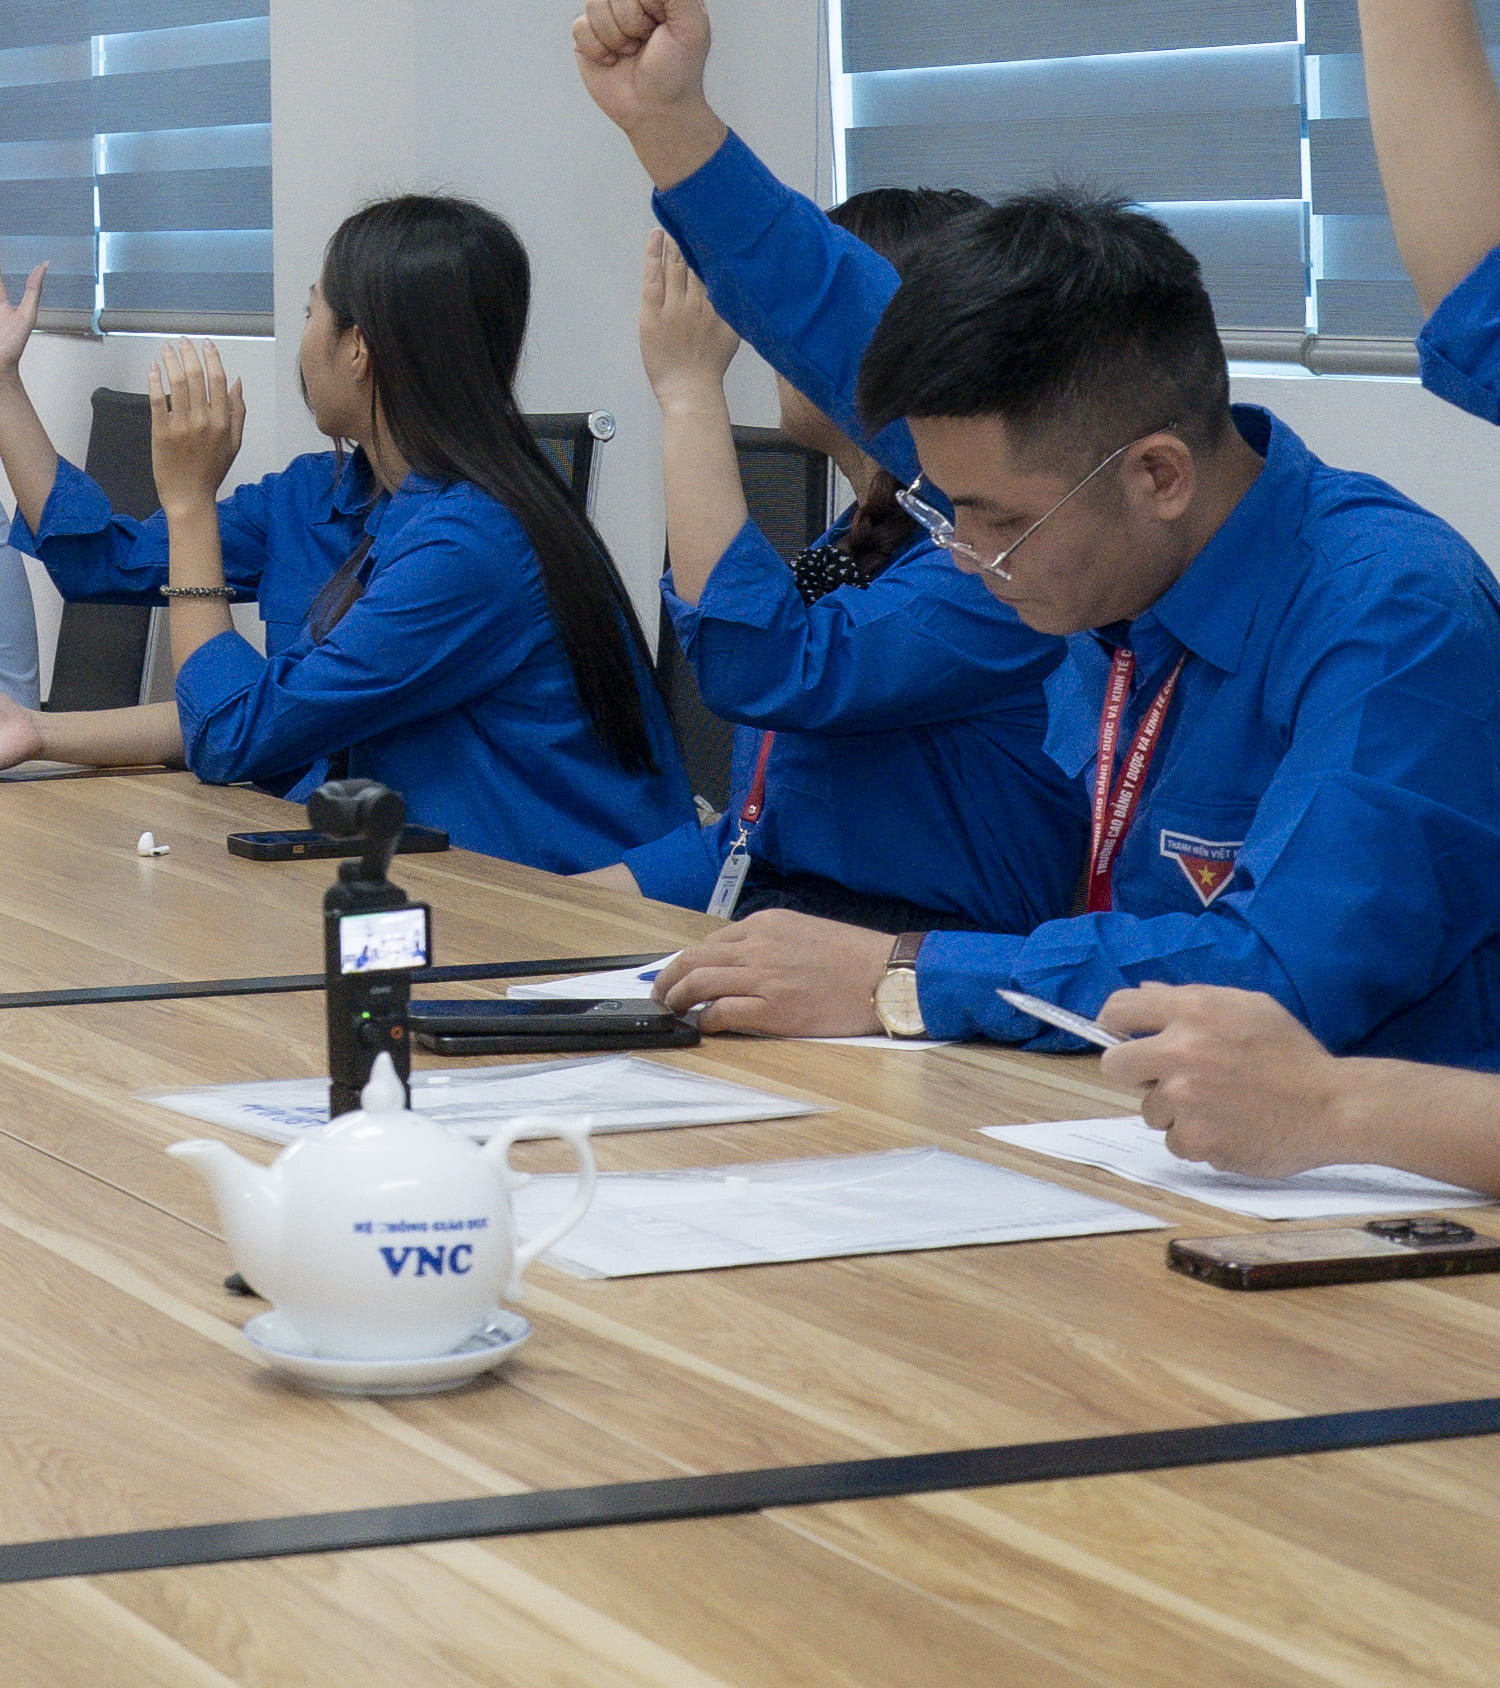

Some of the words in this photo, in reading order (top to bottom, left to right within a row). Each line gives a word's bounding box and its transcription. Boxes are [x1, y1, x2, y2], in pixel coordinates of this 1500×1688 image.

[1111, 675, 1126, 702] KINH
[1108, 819, 1124, 838] CAO
[380, 1244, 473, 1277] VNC
